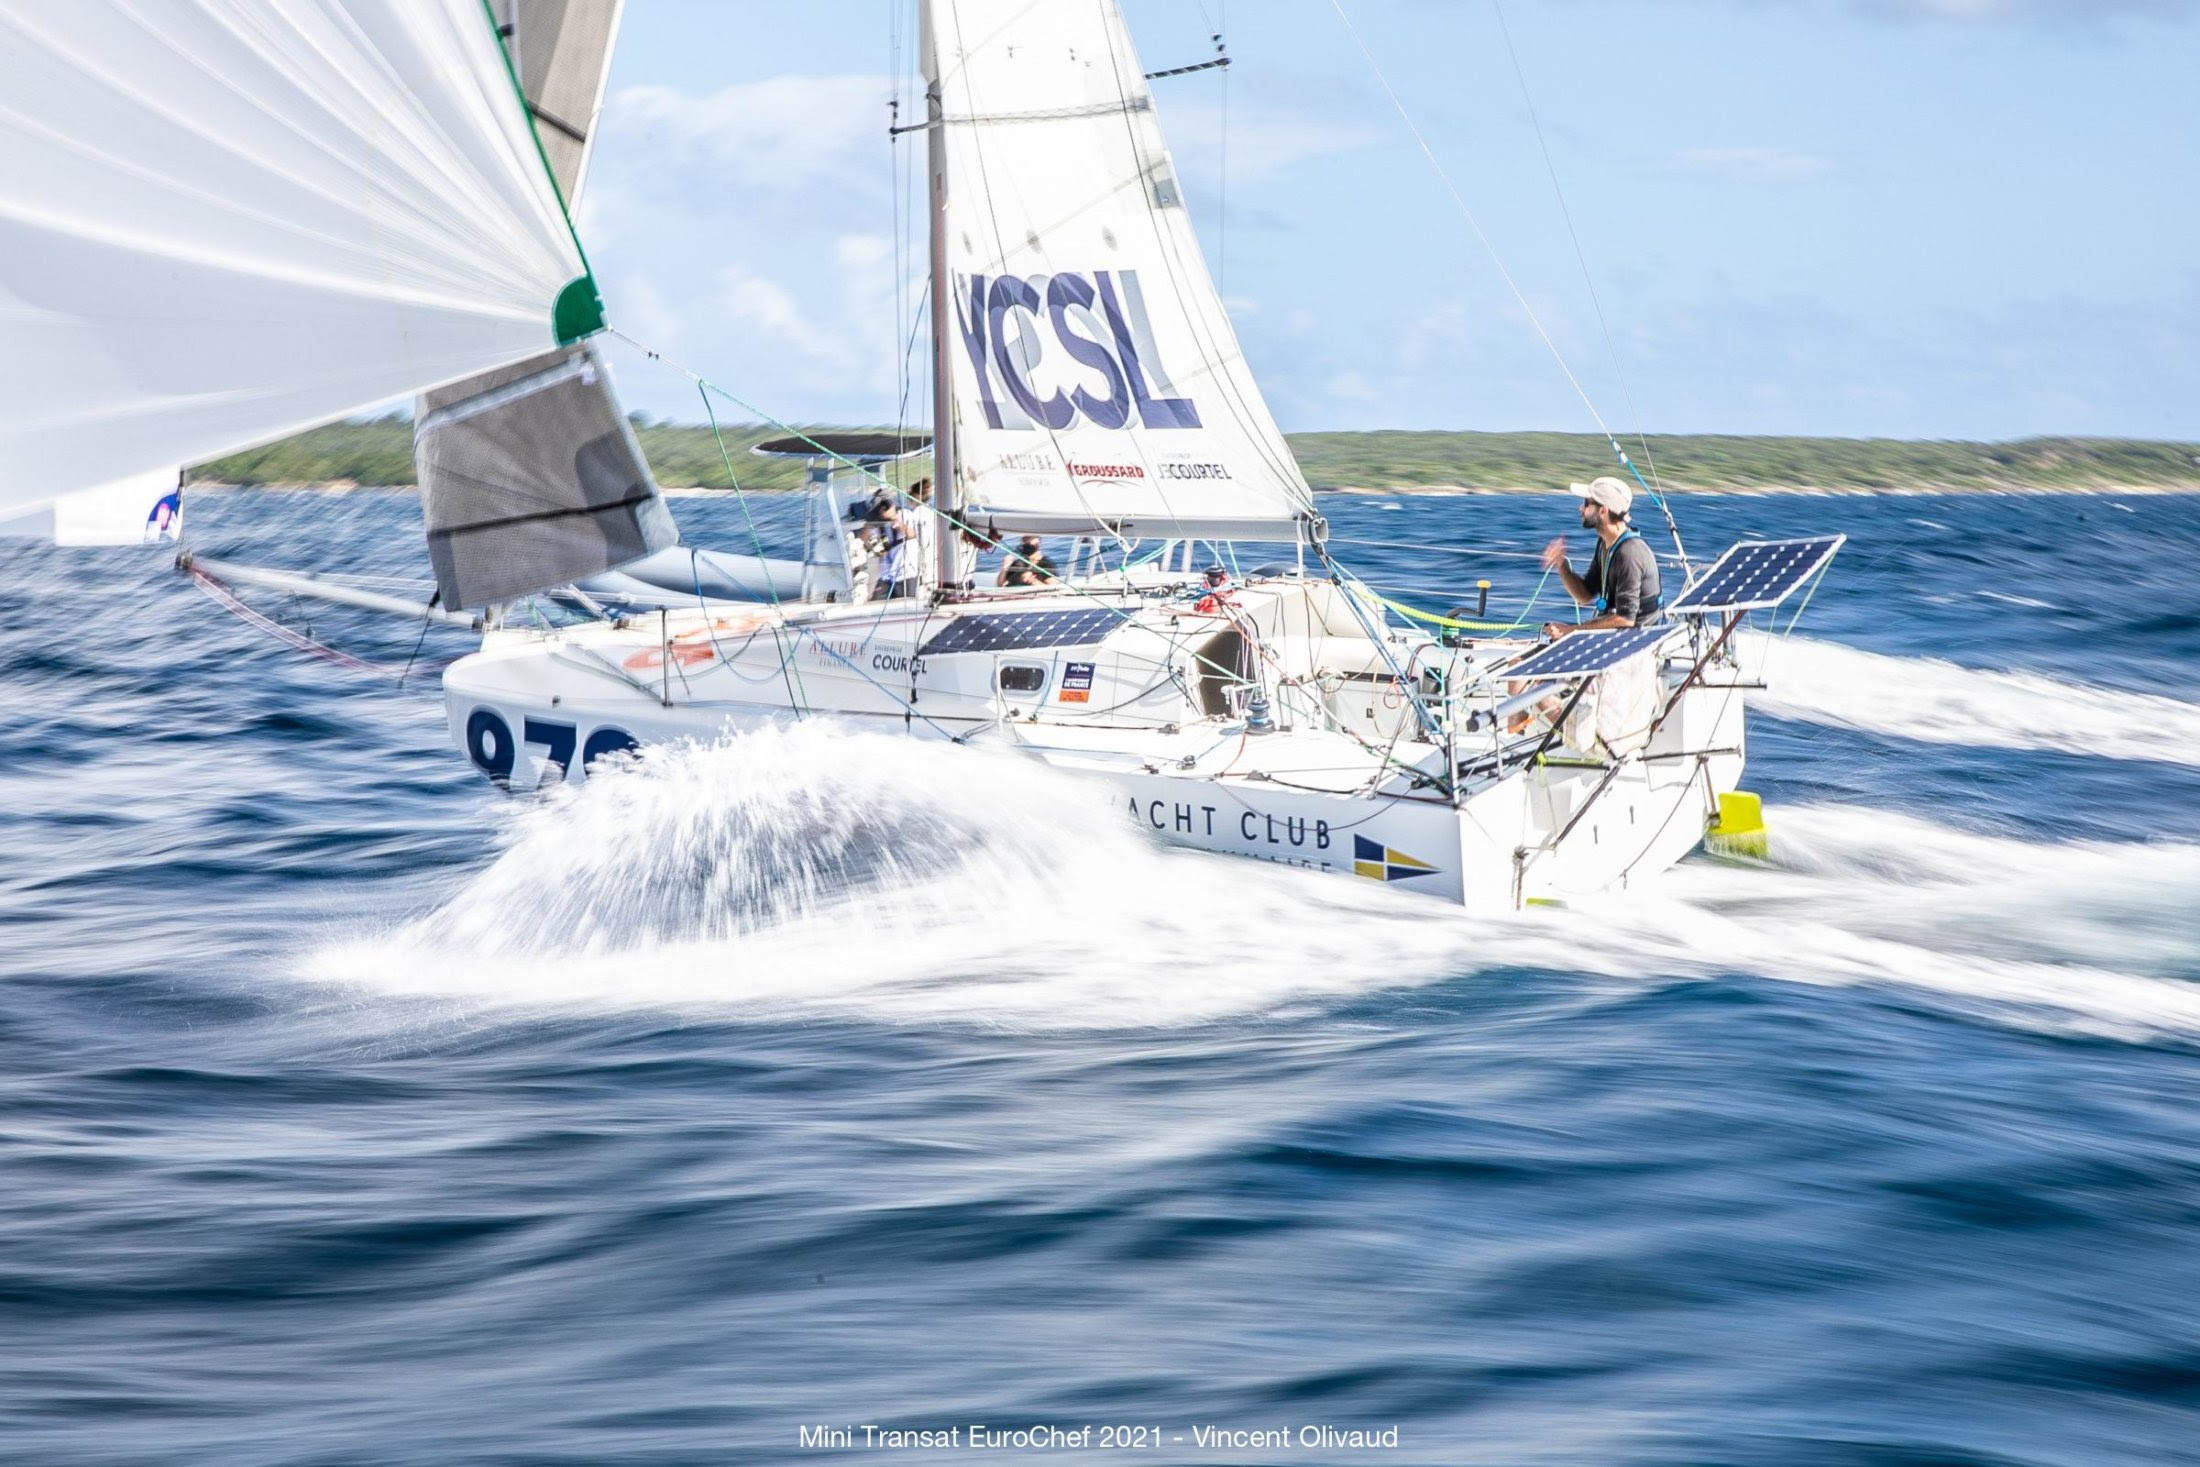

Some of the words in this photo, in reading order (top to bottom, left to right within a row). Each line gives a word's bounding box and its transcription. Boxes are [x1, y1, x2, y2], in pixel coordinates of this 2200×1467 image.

[952, 268, 1203, 430] YCSL
[872, 654, 928, 674] COURTEL
[1128, 797, 1216, 835] ACHT
[1241, 811, 1330, 849] CLUB
